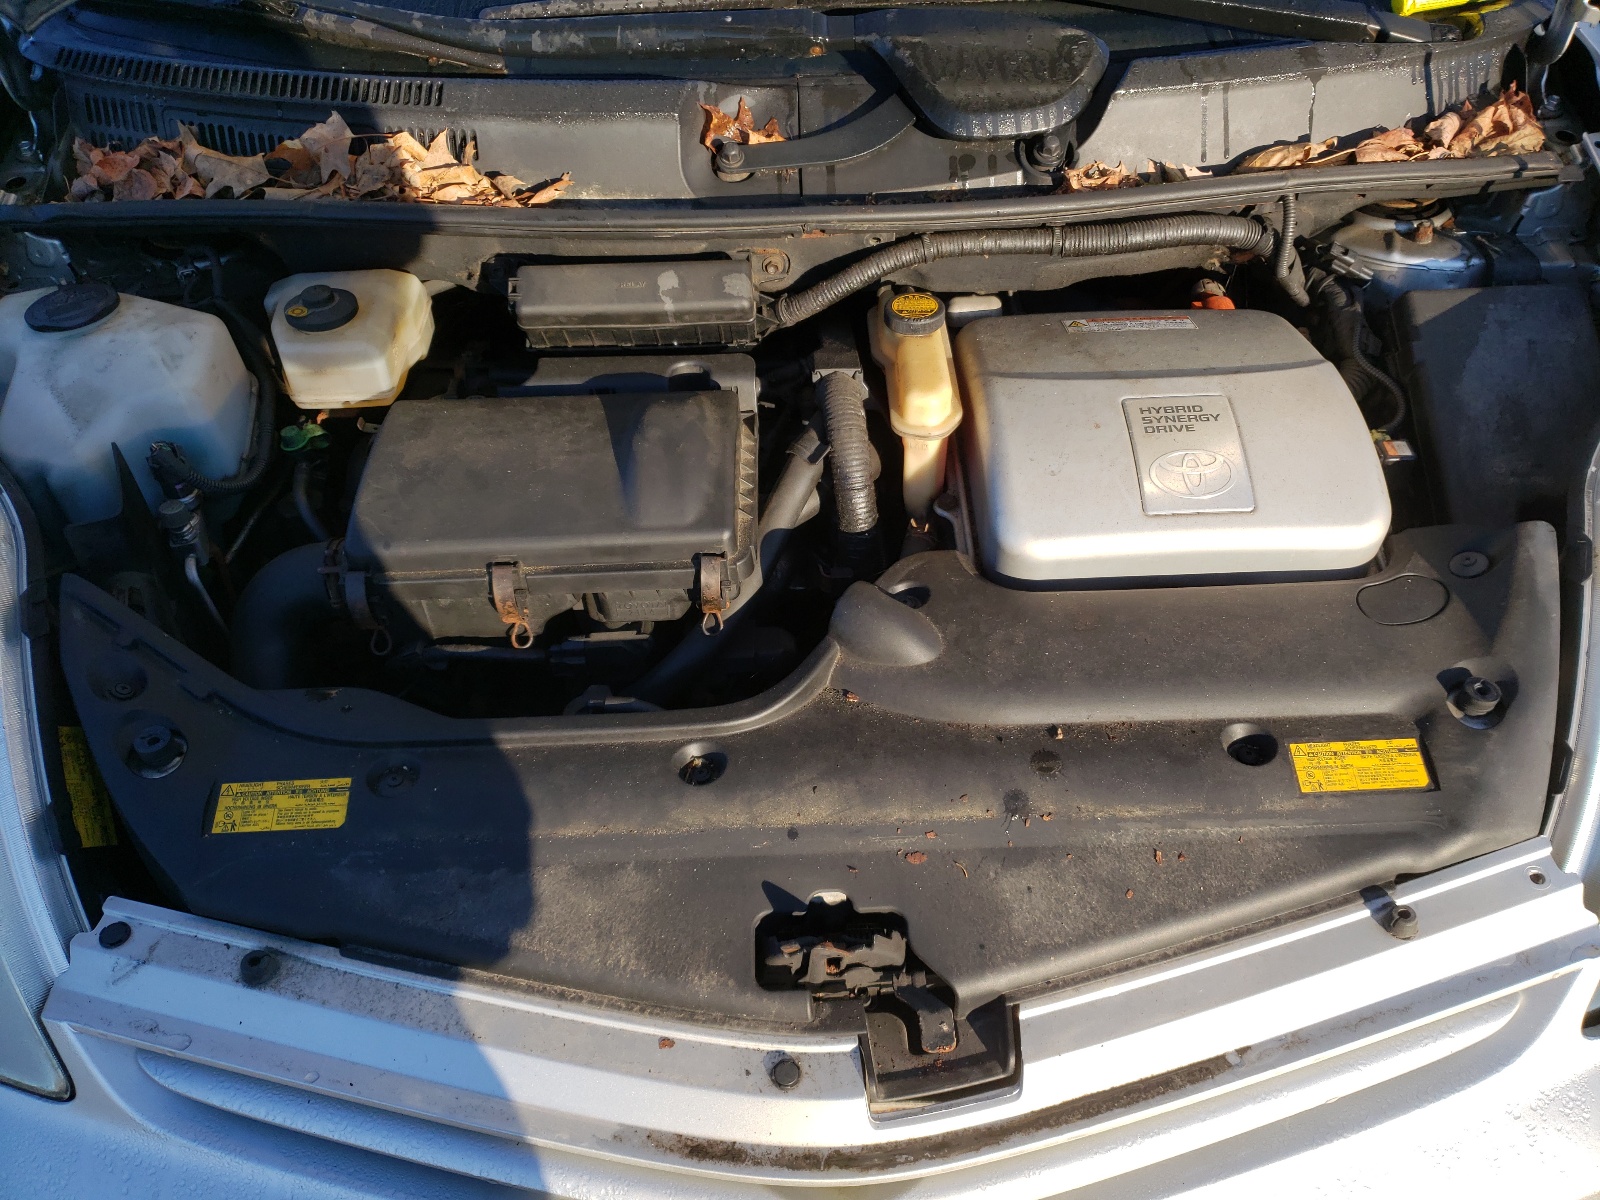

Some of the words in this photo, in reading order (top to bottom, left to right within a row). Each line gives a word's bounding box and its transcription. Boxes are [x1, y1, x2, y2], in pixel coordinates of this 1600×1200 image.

[1139, 405, 1204, 415] HYBRID
[1141, 413, 1221, 425] SYNERGY
[1143, 424, 1196, 434] DRIVE
